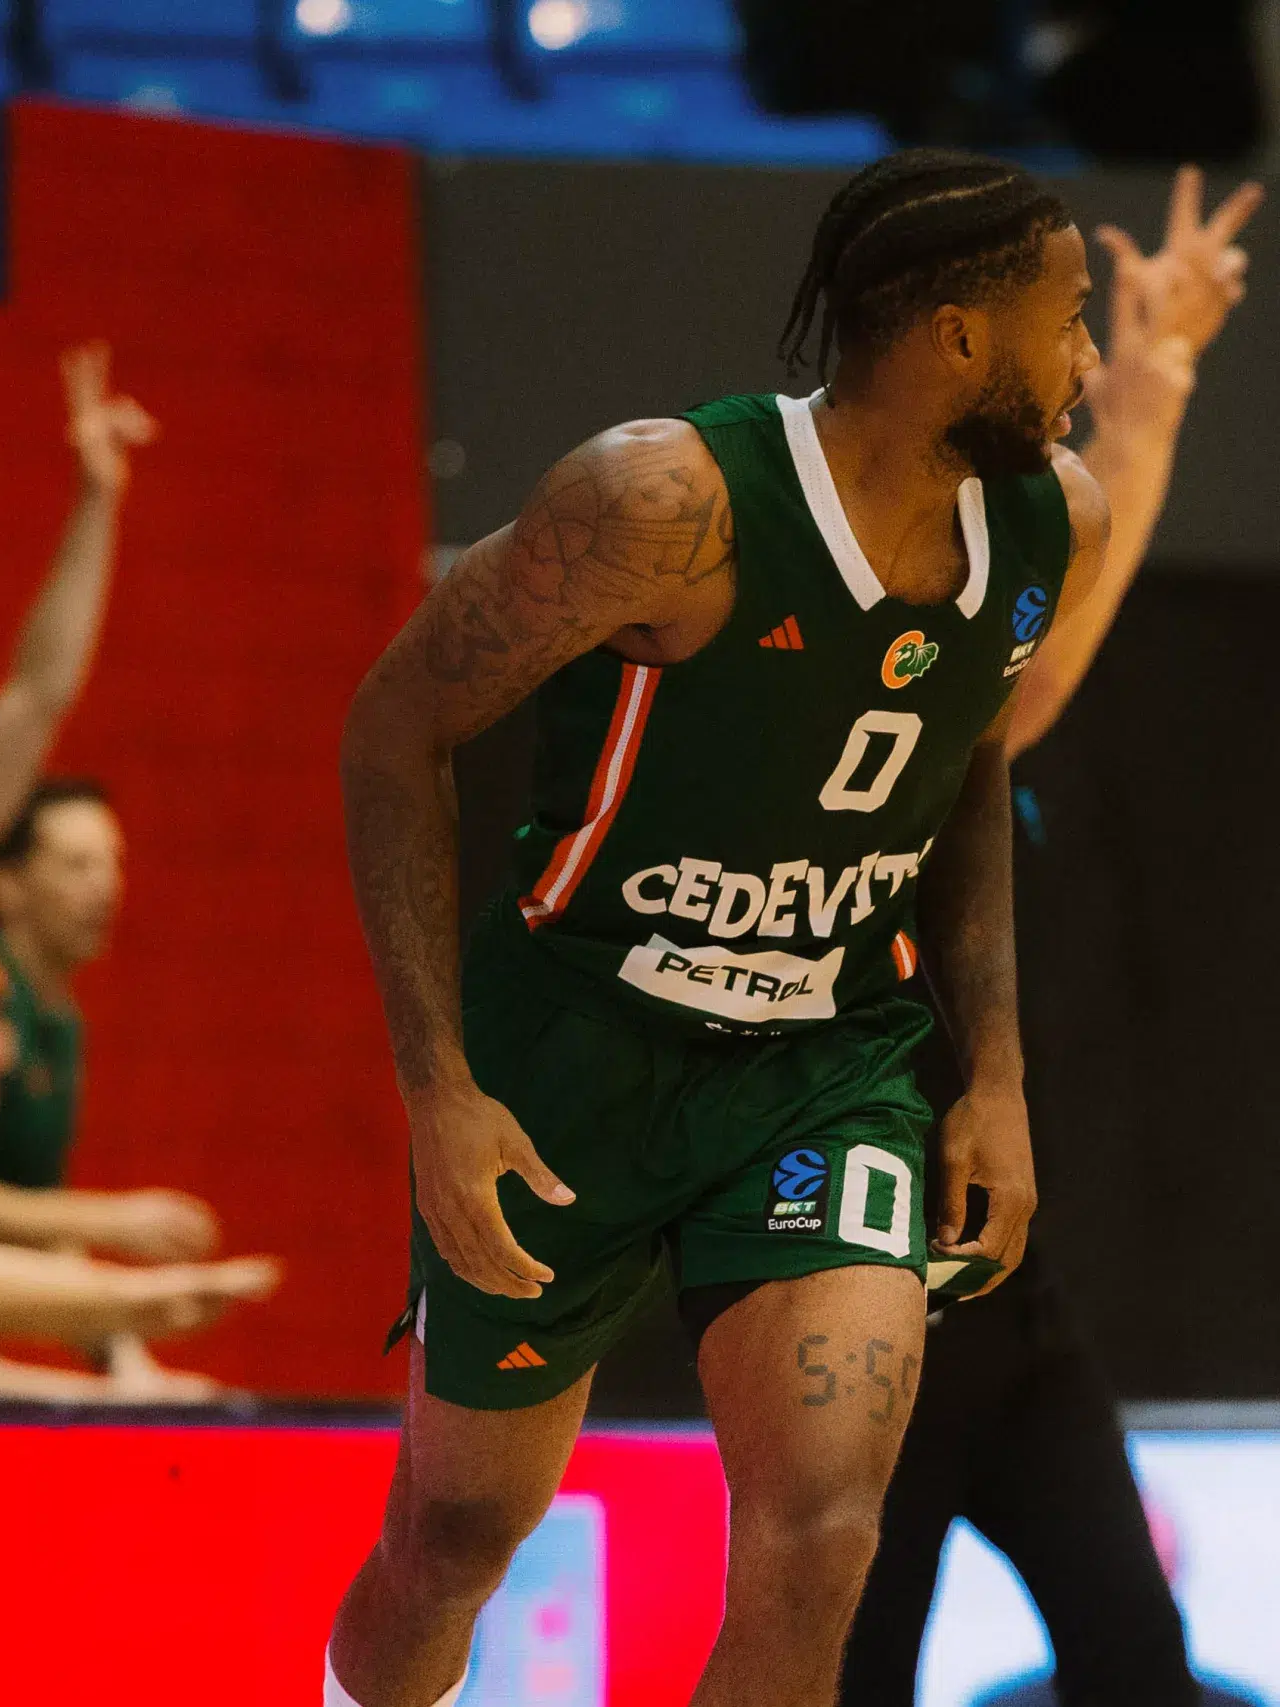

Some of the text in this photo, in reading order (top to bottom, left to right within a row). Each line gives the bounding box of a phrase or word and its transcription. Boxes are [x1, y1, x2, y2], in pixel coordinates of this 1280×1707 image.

[819, 709, 923, 813] 0
[622, 837, 934, 938] CEDEVIT
[655, 950, 814, 1002] PETROL
[767, 1216, 822, 1230] EuroCup
[773, 1200, 817, 1216] BKT
[838, 1143, 913, 1259] 0
